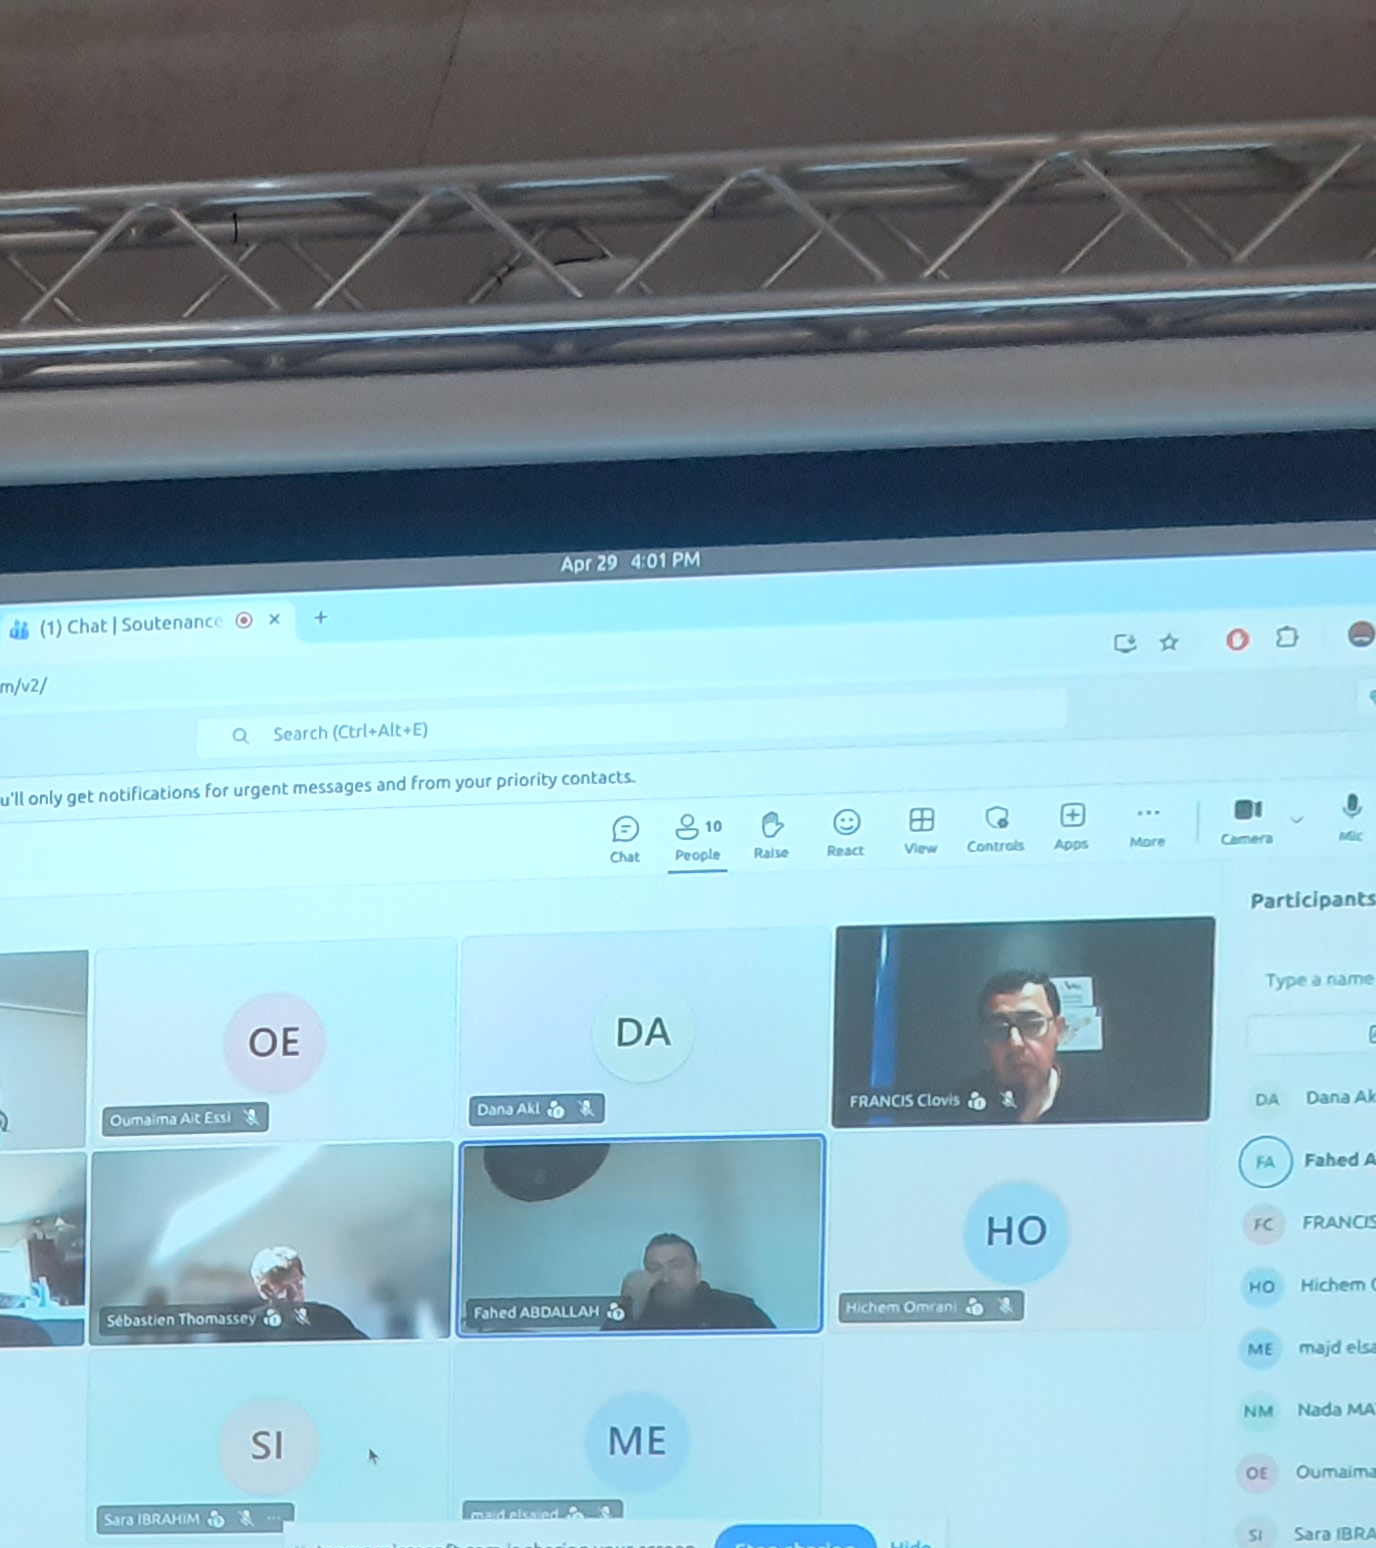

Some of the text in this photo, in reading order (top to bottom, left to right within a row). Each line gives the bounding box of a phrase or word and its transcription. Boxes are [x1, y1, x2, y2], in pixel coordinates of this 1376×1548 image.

[561, 551, 701, 573] Apr 29 4:01 PM
[40, 619, 63, 639] (1)
[68, 618, 108, 634] Chat
[121, 615, 223, 632] Soutenance
[273, 721, 429, 743] Search (Ctrl+Alt+E)
[28, 789, 62, 808] only
[67, 789, 94, 807] get
[98, 785, 201, 803] notifications
[205, 783, 229, 798] for
[233, 782, 289, 800] urgent
[293, 780, 372, 797] messages
[376, 776, 406, 792] and
[411, 774, 450, 791] from
[455, 773, 492, 793] your
[497, 770, 558, 790] priority
[561, 769, 636, 787] contacts.
[705, 820, 723, 833] 10
[1129, 836, 1166, 849] More
[1220, 833, 1274, 846] Camera
[1338, 830, 1364, 843] Mic
[826, 845, 866, 857] React
[904, 842, 938, 855] View
[967, 839, 1025, 853] Controls
[1054, 838, 1089, 852] Apps
[609, 851, 641, 863] Chat
[675, 849, 721, 863] People
[753, 847, 789, 859] Raise
[1251, 891, 1376, 911] Participants
[1265, 972, 1375, 991] Type a name
[616, 1016, 672, 1047] DA
[248, 1027, 300, 1057] OE
[850, 1092, 961, 1109] FRANCIS Clovis
[1255, 1093, 1280, 1106] DA
[1306, 1090, 1350, 1105] Dana
[477, 1101, 541, 1116] Dana Akl
[110, 1112, 178, 1128] Oumaima
[204, 1110, 231, 1124] Essi
[1255, 1155, 1276, 1169] FA
[1304, 1152, 1359, 1168] Fahed
[1253, 1217, 1274, 1231] FC
[1302, 1215, 1376, 1230] FRANCIS
[986, 1215, 1048, 1246] HO
[1249, 1280, 1275, 1294] HO
[1301, 1278, 1366, 1293] Hichem
[474, 1304, 600, 1320] Fahed ABDALLAH
[845, 1300, 958, 1314] Hichem Omrani
[106, 1311, 257, 1328] Sébastien Thomassey
[1248, 1342, 1273, 1356] ME
[1299, 1339, 1342, 1358] majd
[1244, 1404, 1274, 1418] NM
[1298, 1402, 1376, 1417] Nada MA
[251, 1430, 283, 1460] SI
[608, 1425, 667, 1456] ME
[1245, 1467, 1269, 1480] OE
[1296, 1464, 1376, 1479] Oumaima
[103, 1512, 200, 1527] Sara IBRAHIM
[1248, 1529, 1263, 1542] SI
[1294, 1526, 1332, 1542] Sara
